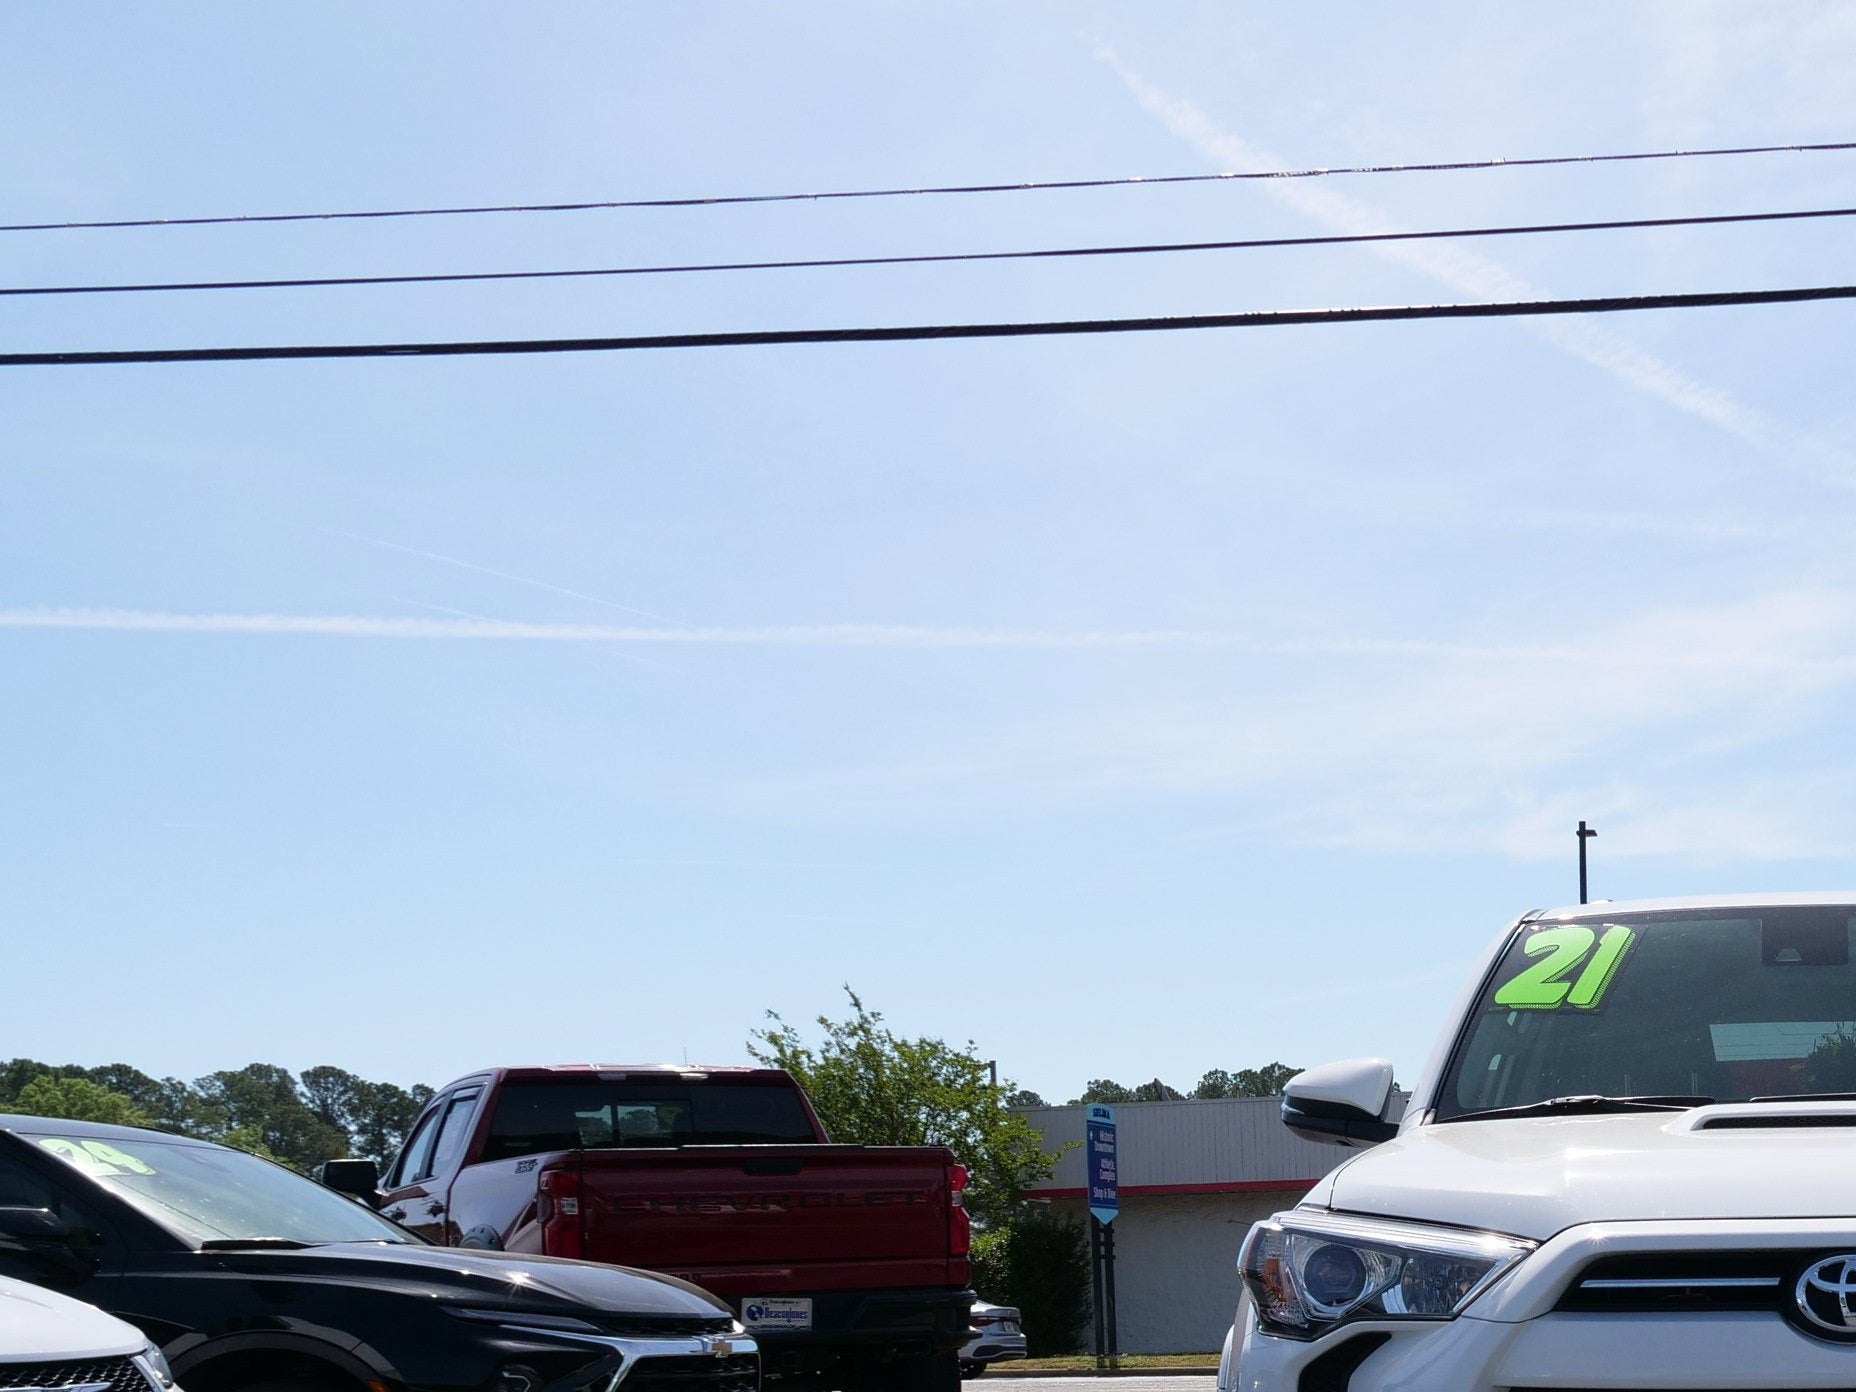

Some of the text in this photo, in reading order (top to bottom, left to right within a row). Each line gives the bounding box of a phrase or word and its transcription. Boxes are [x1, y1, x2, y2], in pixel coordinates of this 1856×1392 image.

[1494, 925, 1636, 1010] 21
[1092, 1108, 1111, 1120] SELMA
[611, 1190, 929, 1213] CHEVROLET
